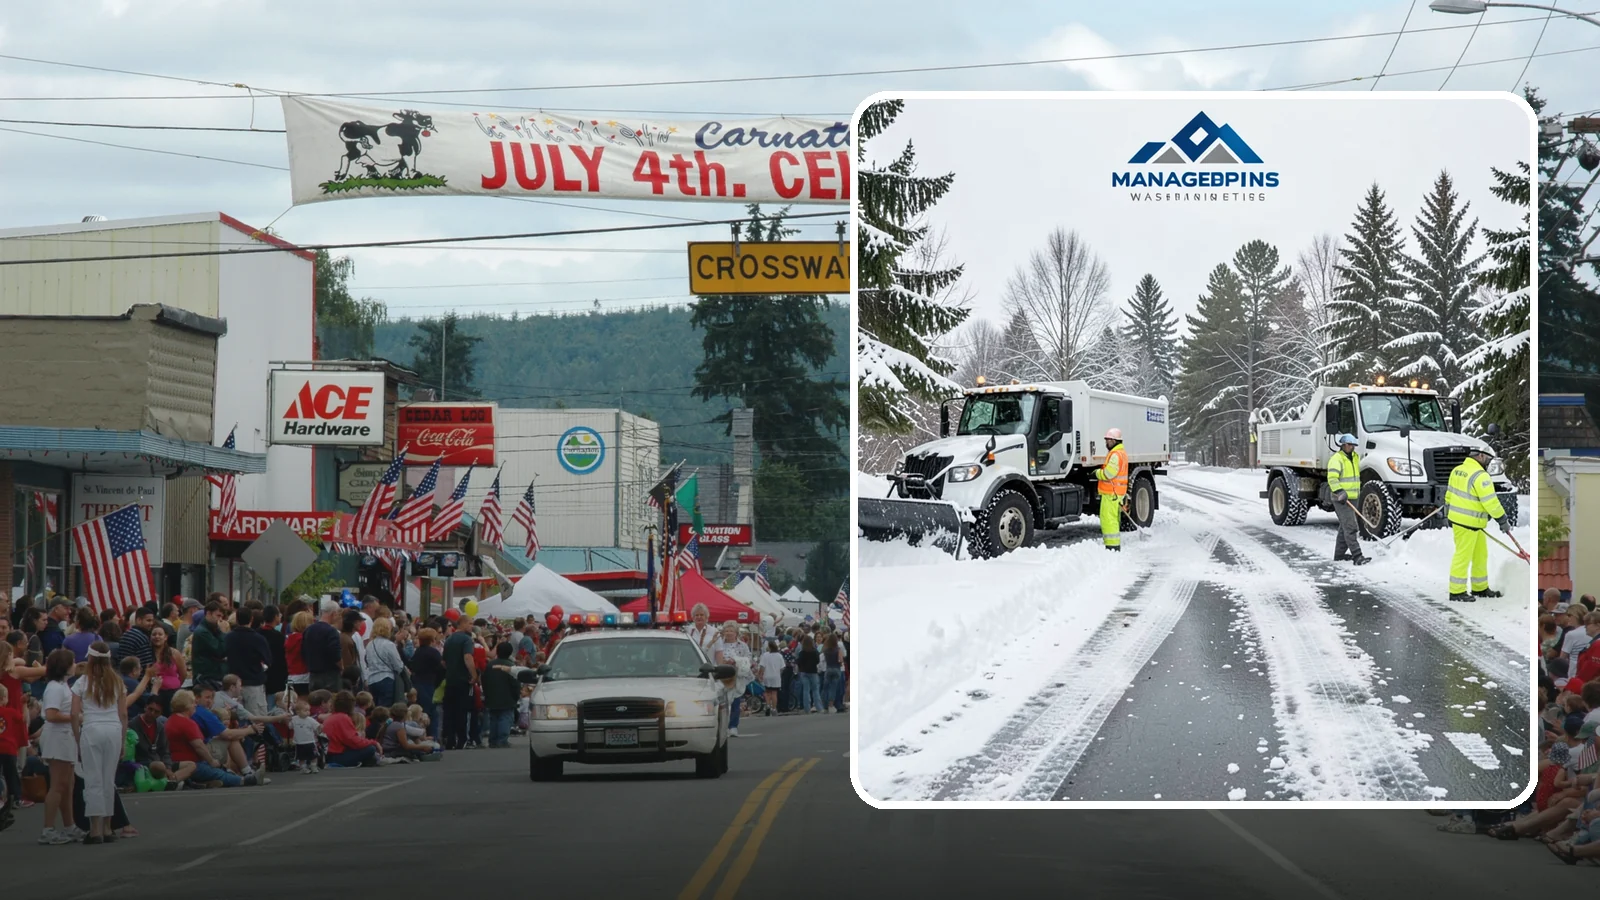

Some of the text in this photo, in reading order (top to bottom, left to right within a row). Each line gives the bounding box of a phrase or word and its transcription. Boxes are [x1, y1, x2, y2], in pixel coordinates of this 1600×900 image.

[481, 141, 605, 192] JULY
[632, 150, 746, 198] 4th.
[697, 254, 850, 279] CROSSWA
[282, 380, 374, 420] ACE
[406, 409, 452, 422] CEDAR
[284, 421, 371, 436] Hardware
[95, 485, 124, 495] Vincent
[126, 485, 136, 495] de
[137, 486, 155, 496] Paul
[699, 535, 730, 543] GLASS
